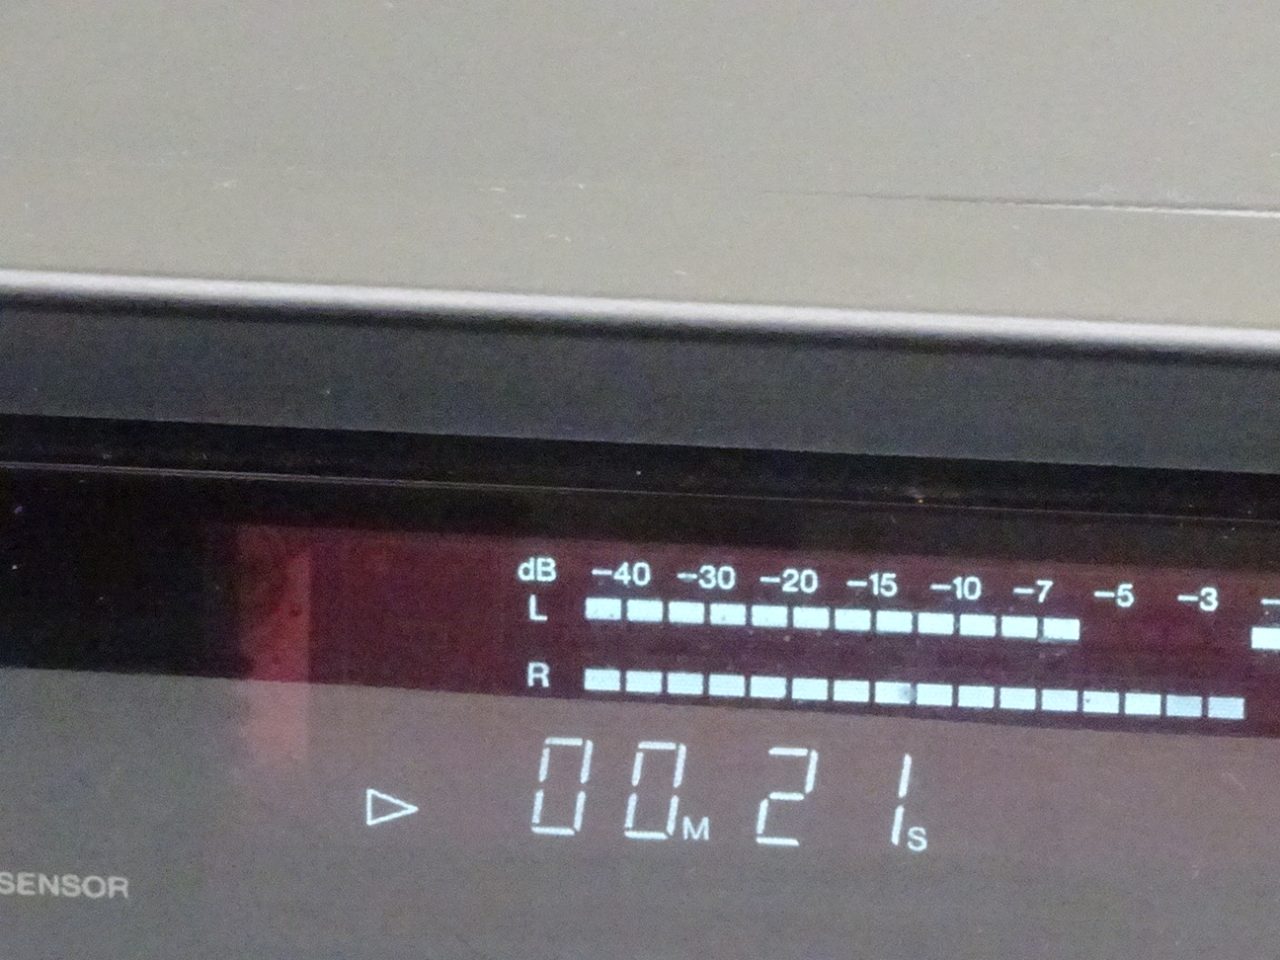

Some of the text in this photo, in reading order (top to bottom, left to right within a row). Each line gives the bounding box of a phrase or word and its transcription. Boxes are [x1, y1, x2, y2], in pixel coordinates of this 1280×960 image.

[517, 557, 557, 582] dB
[528, 594, 548, 621] L
[527, 662, 550, 688] R
[0, 871, 129, 899] SENSOR
